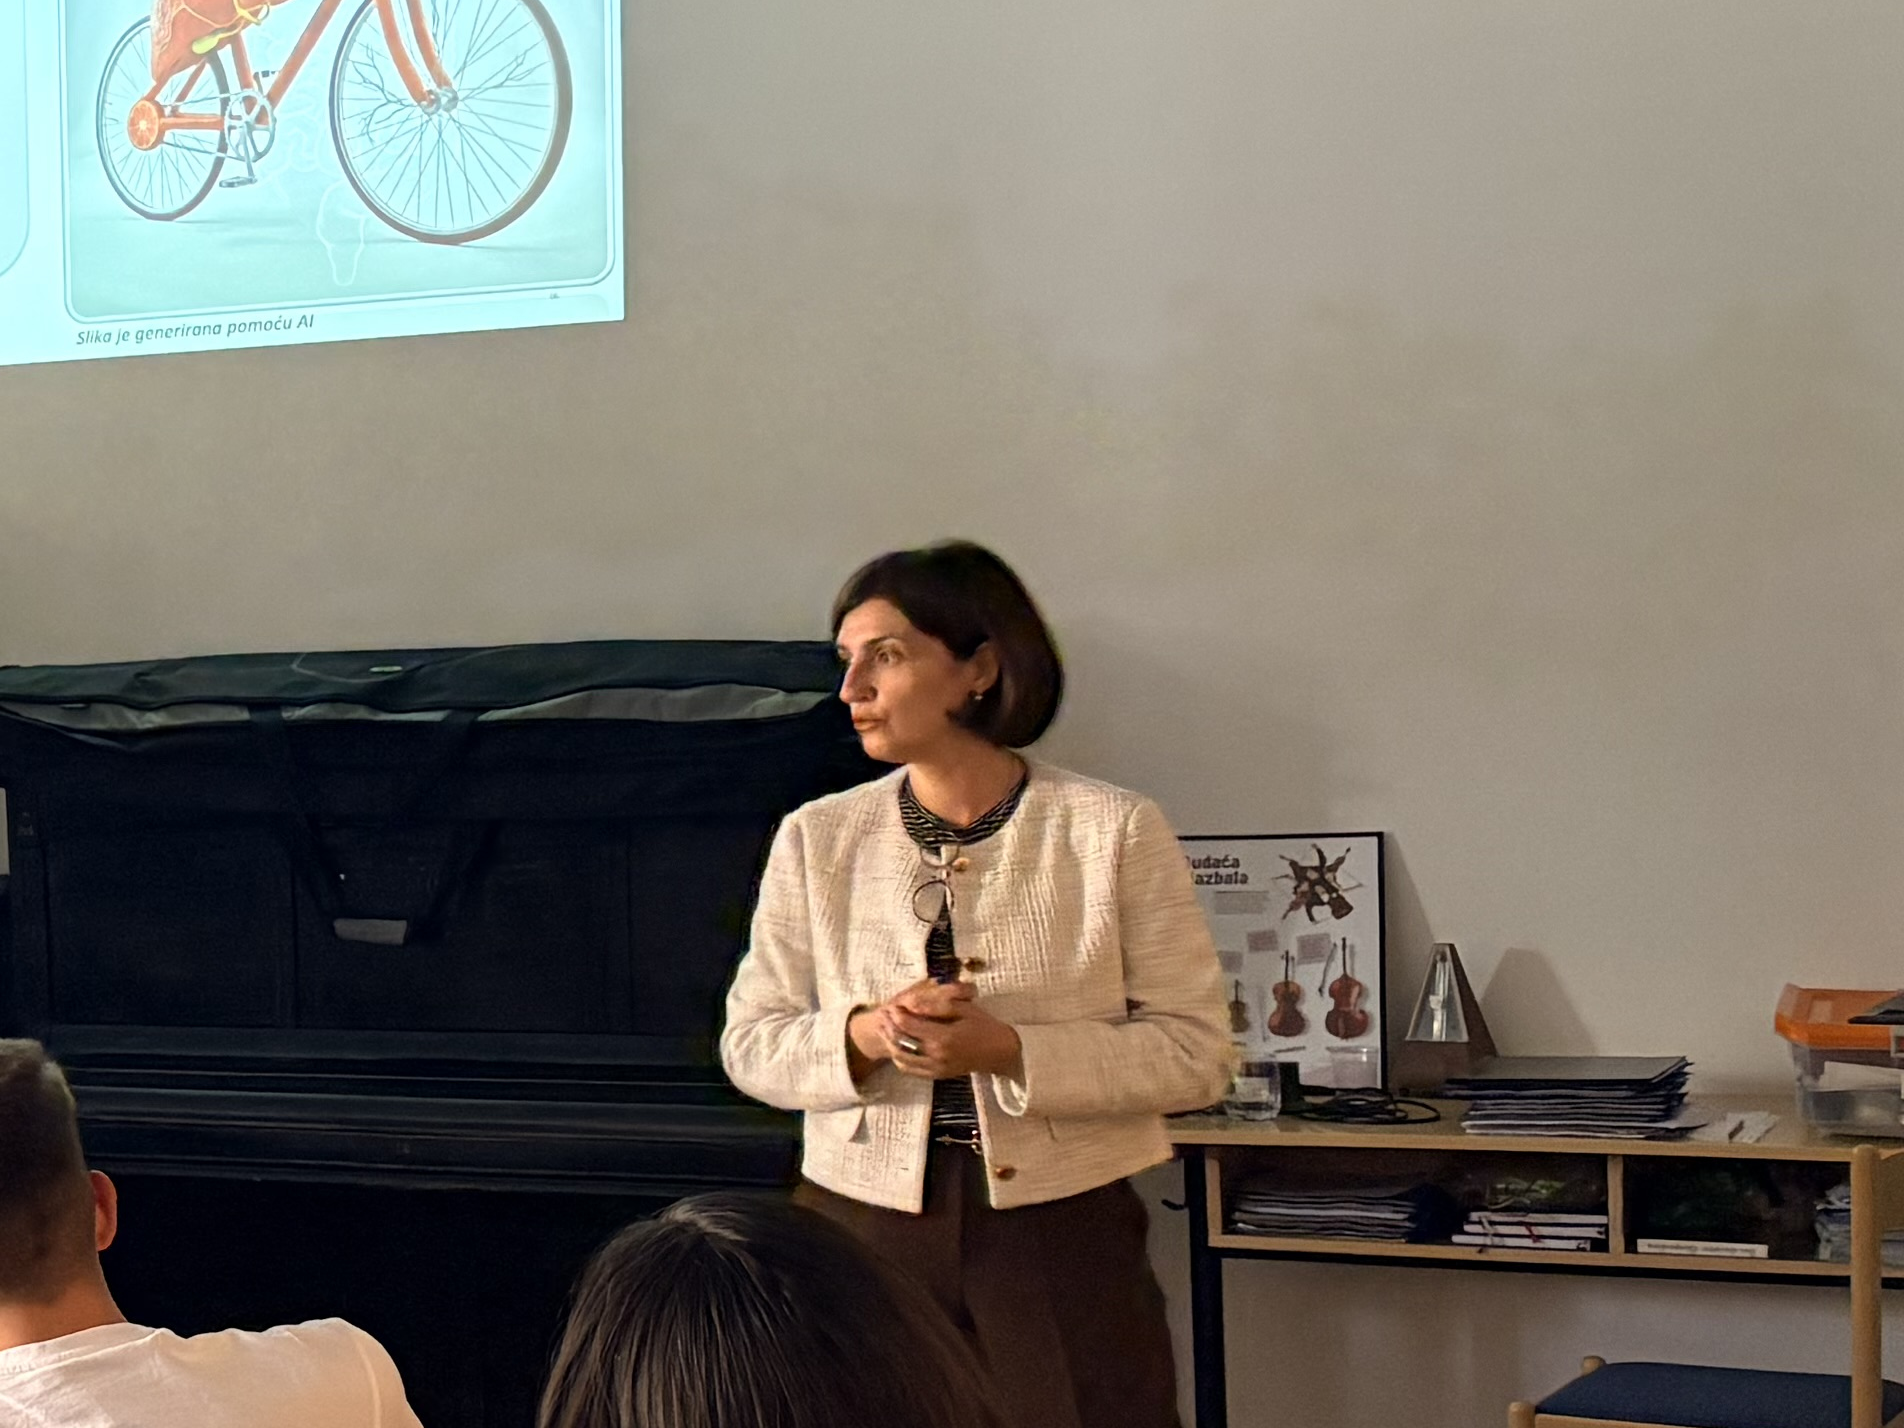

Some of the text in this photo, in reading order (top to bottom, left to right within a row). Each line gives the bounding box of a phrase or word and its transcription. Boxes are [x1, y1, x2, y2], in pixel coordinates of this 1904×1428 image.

[76, 314, 315, 345] Slika je generirana pomoću AI
[1185, 854, 1240, 869] udaća
[1192, 872, 1249, 885] azbala
